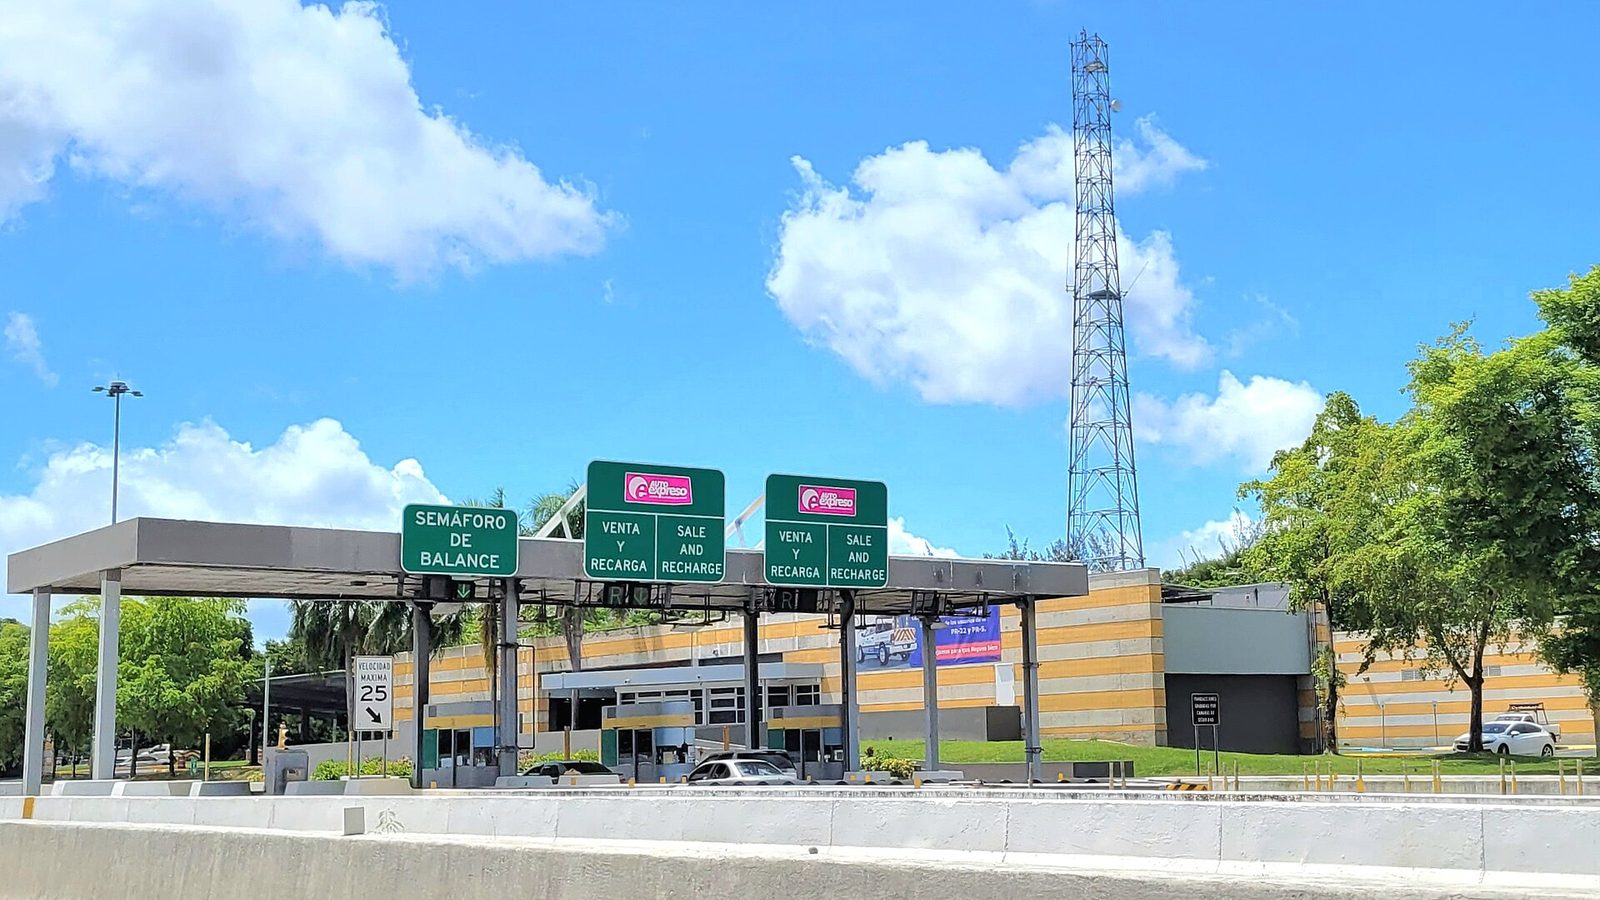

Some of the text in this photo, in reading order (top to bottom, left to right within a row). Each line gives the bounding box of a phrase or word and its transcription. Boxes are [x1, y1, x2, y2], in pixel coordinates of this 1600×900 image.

[650, 480, 669, 488] AUTO
[415, 510, 506, 530] SEMÁFORO
[602, 521, 640, 535] VENTA
[677, 525, 706, 538] SALE
[450, 532, 472, 548] DE
[779, 530, 813, 544] VENTA
[846, 534, 872, 546] SALE
[616, 540, 626, 552] Y
[680, 544, 704, 556] AND
[420, 551, 500, 568] BALANCE
[792, 548, 800, 560] Y
[848, 552, 870, 563] AND
[590, 558, 648, 572] RECARGA
[662, 561, 722, 575] RECHARGE
[770, 565, 820, 578] RECARGA
[830, 568, 886, 580] RECHARGE
[358, 662, 390, 670] VELOCIDAD
[360, 674, 388, 682] MAXIMA
[360, 685, 387, 702] 25
